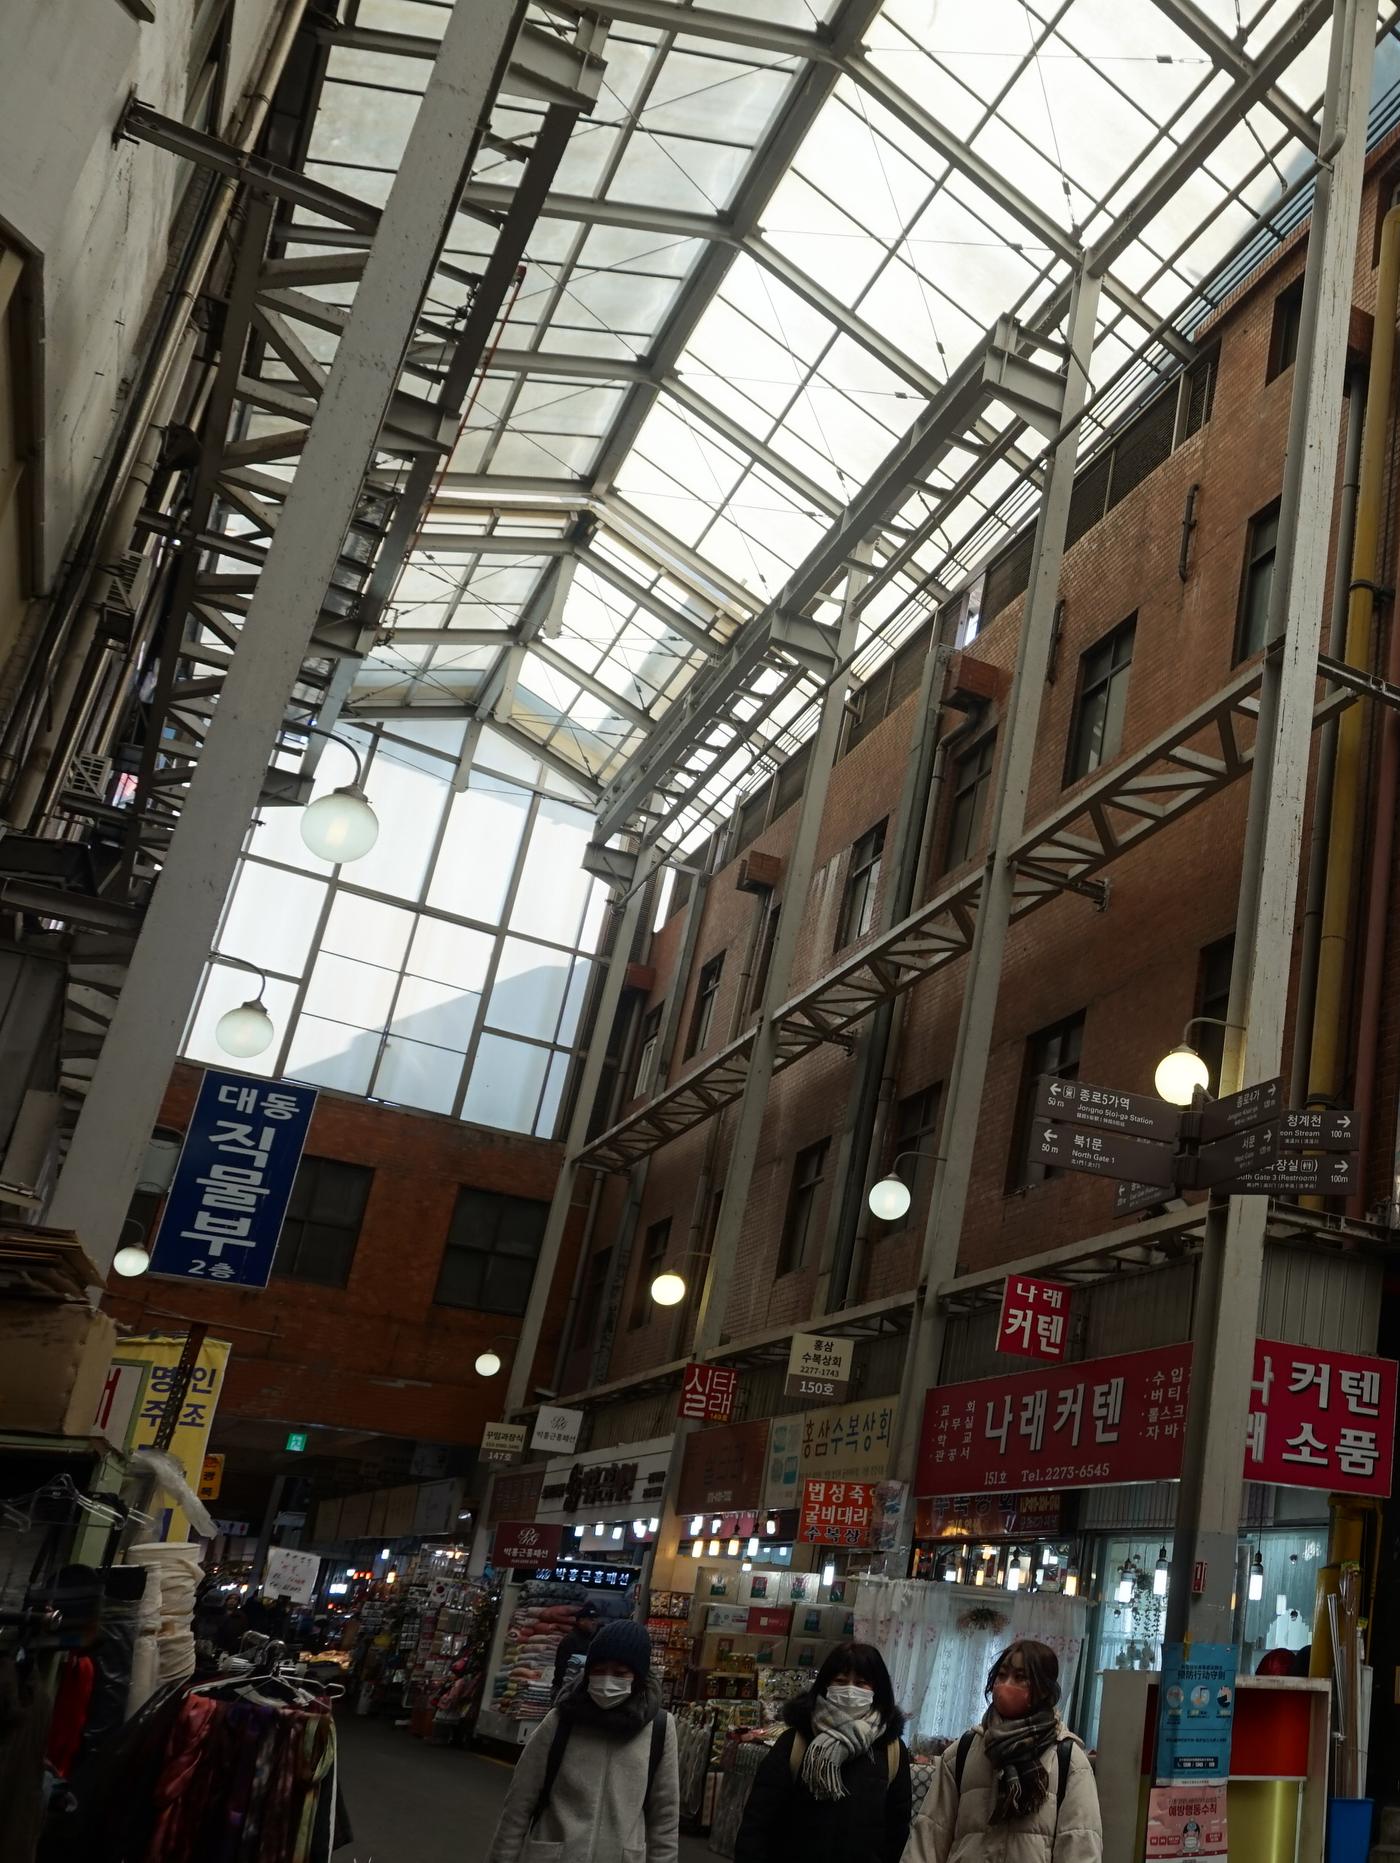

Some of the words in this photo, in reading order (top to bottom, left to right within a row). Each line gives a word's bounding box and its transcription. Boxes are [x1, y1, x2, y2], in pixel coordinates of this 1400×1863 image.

[217, 1084, 300, 1121] 대동
[1047, 1097, 1056, 1106] 50
[1080, 1088, 1130, 1110] 종로5가역
[1077, 1104, 1103, 1115] Jongno
[1129, 1114, 1154, 1125] Station
[1288, 1114, 1321, 1127] 청계천
[1041, 1143, 1050, 1152] 50
[1073, 1134, 1102, 1151] 북1문
[1072, 1149, 1092, 1160] North
[1093, 1152, 1110, 1163] Gate
[1278, 1174, 1318, 1182] (Restroom)
[180, 1119, 276, 1257] 직물부
[188, 1259, 236, 1279] 2층
[1016, 1281, 1063, 1309] 나래
[1004, 1307, 1064, 1355] 커텐
[814, 1340, 834, 1352] 홍삼
[802, 1352, 842, 1367] 수복상회
[800, 1366, 839, 1377] 2277-1743
[1151, 1367, 1191, 1387] 수입
[799, 1381, 834, 1396] 150호
[1150, 1385, 1189, 1404] 버티
[1288, 1361, 1381, 1417] 커텐
[984, 1376, 1125, 1455] 나래커텐
[1145, 1422, 1187, 1441] 자바
[1281, 1422, 1380, 1476] 소품
[984, 1470, 1008, 1486] 151호
[1021, 1463, 1110, 1483] Tel.2273-6545
[805, 1503, 871, 1526] 굴비대리
[805, 1525, 870, 1543] 수복상
[555, 1567, 630, 1586] 박홍근홈패션
